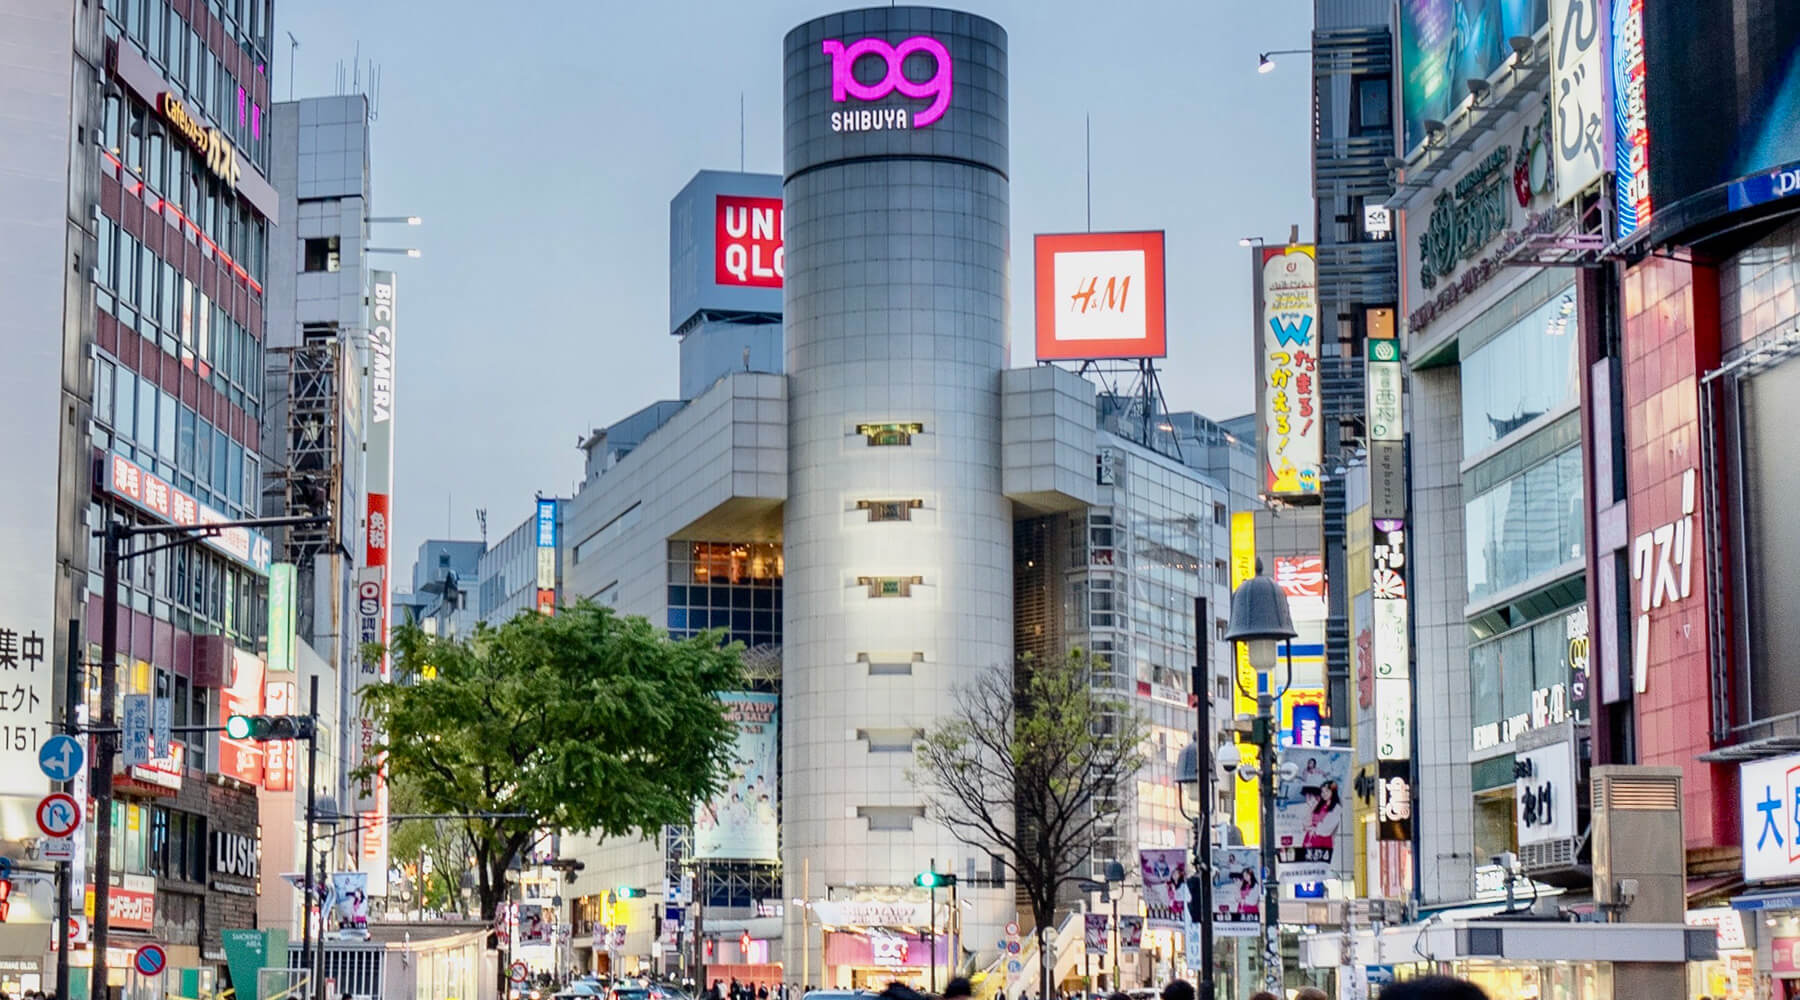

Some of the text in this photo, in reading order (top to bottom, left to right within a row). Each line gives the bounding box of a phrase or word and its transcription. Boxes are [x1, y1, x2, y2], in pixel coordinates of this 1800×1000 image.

[823, 35, 952, 129] 109
[832, 109, 908, 132] SHIBUYA
[1071, 276, 1130, 314] H&M
[368, 283, 392, 423] BIC CAMERA
[252, 536, 270, 567] 4F
[0, 628, 44, 673] 集中
[3, 725, 37, 752] 151
[134, 699, 146, 759] 渋谷駅前
[217, 831, 256, 878] LUSH
